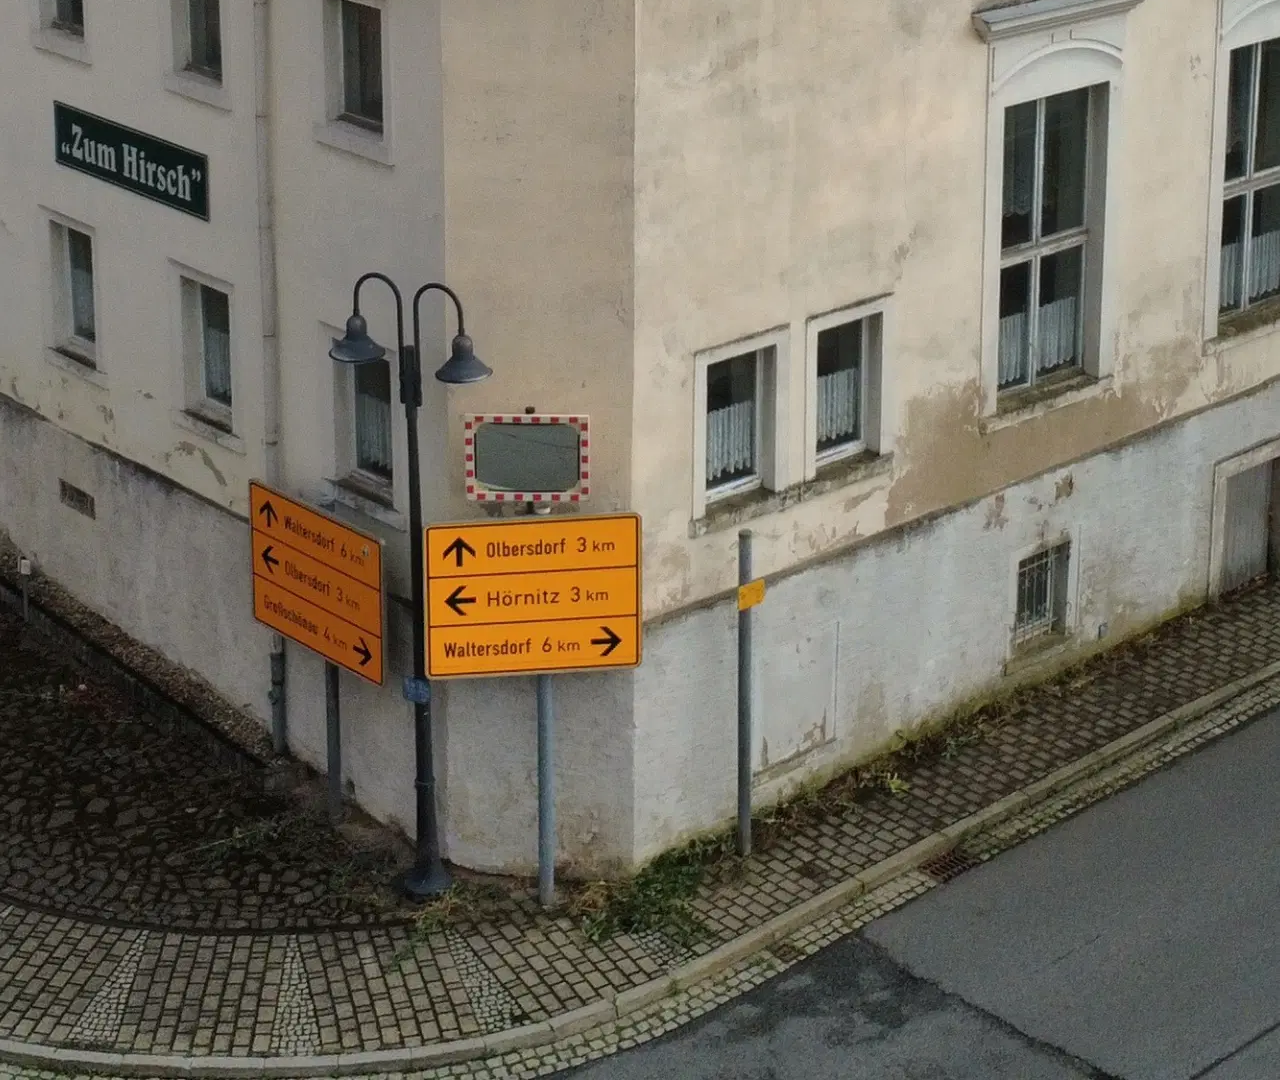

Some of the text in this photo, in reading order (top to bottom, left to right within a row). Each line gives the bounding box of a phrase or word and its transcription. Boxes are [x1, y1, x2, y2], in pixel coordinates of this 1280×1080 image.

[283, 515, 365, 567] Waltersdorf 6 km
[486, 536, 616, 558] Olbersdorf 3 km
[284, 560, 360, 612] Olbersdorf 3 km
[487, 586, 609, 608] Hörnitz 3 km
[263, 594, 348, 651] Großschönau 4 km
[444, 637, 580, 659] Waltersdorf 6 km
